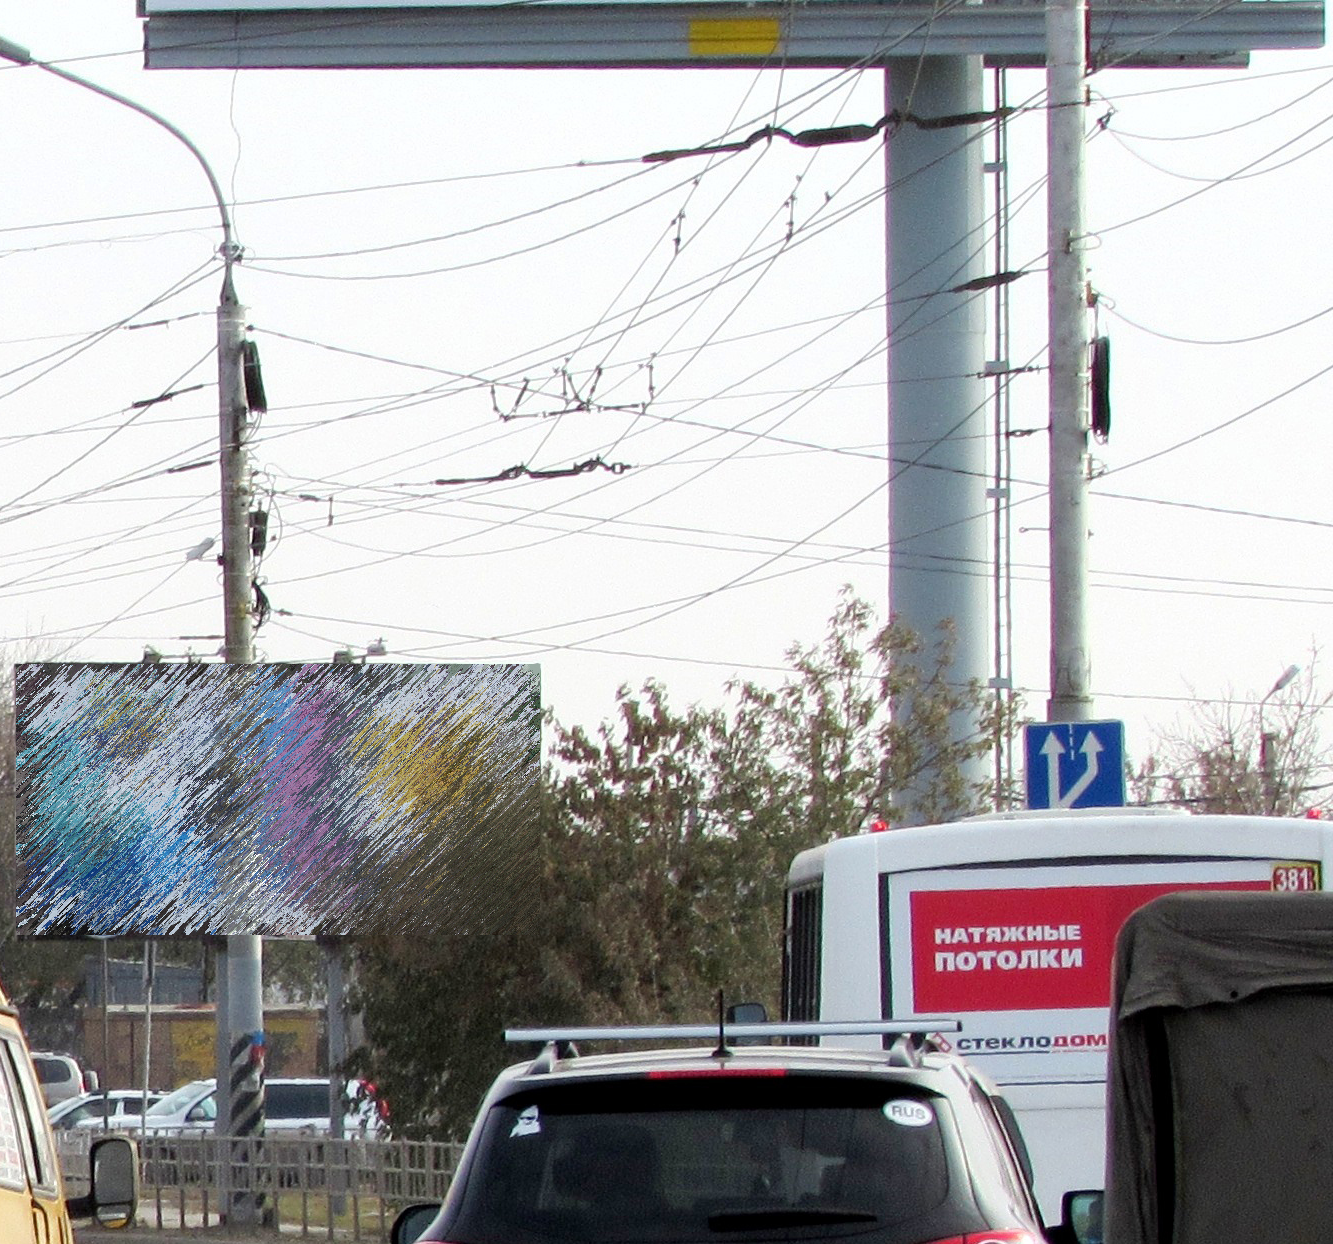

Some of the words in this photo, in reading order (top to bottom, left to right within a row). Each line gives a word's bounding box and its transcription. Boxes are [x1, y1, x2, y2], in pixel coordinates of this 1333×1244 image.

[1276, 868, 1308, 891] 381
[934, 925, 1081, 944] НАТЯЖНЫЕ
[935, 948, 1083, 972] ПОТОЛКИ
[892, 1105, 926, 1120] RUS
